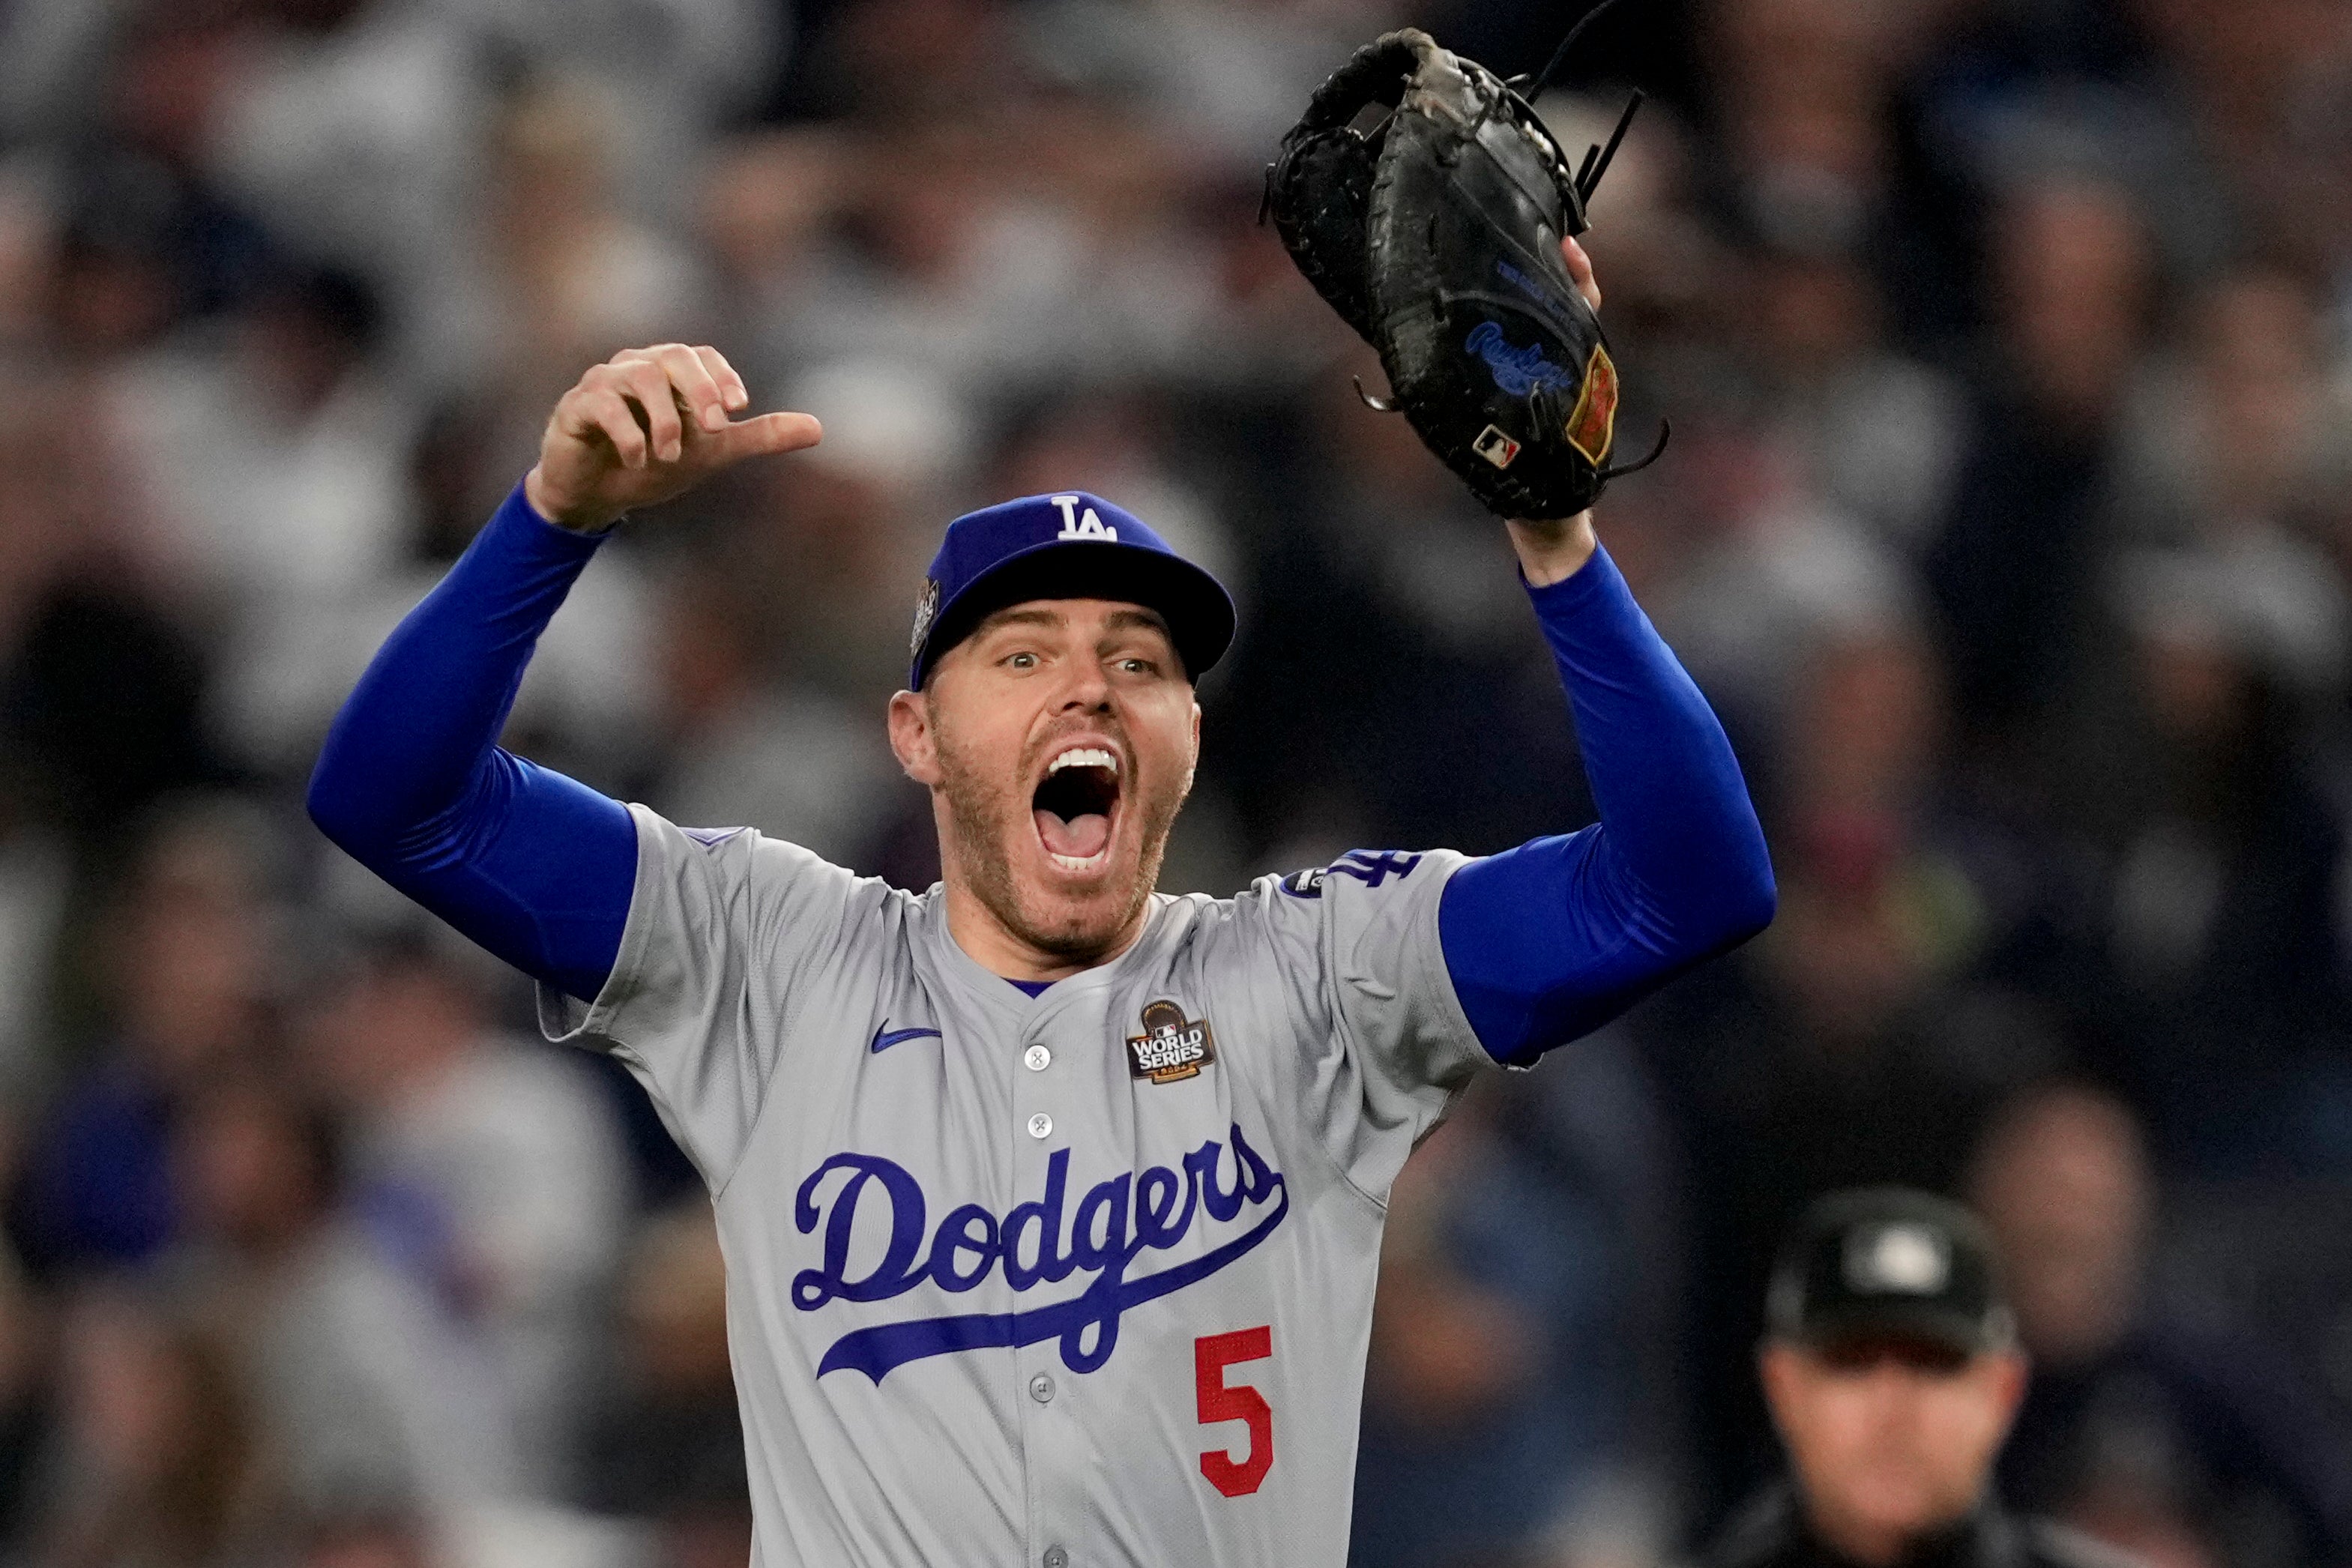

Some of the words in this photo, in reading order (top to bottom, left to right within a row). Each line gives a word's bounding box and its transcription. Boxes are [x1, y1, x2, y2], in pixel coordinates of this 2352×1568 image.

[1051, 495, 1118, 542] LA
[1132, 1029, 1202, 1058] WORLD
[1139, 1043, 1204, 1070] SERIES
[791, 1123, 1288, 1375] Dodgers
[1194, 1325, 1273, 1498] 5
